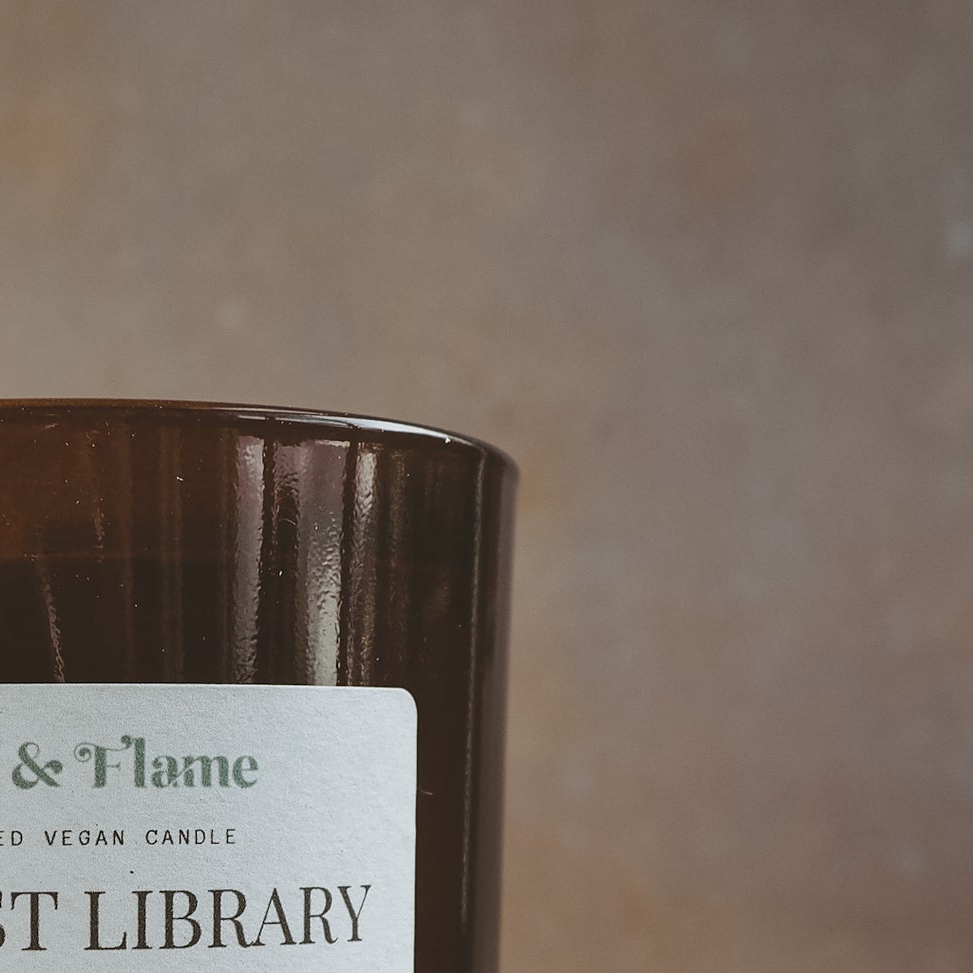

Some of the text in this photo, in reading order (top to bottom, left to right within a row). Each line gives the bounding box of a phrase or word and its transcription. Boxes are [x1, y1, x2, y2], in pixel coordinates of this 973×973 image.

[11, 741, 63, 790] &
[74, 734, 259, 789] Flame
[43, 829, 125, 847] VEGAN
[144, 828, 236, 846] CANDLE
[83, 884, 372, 951] LIBRARY
